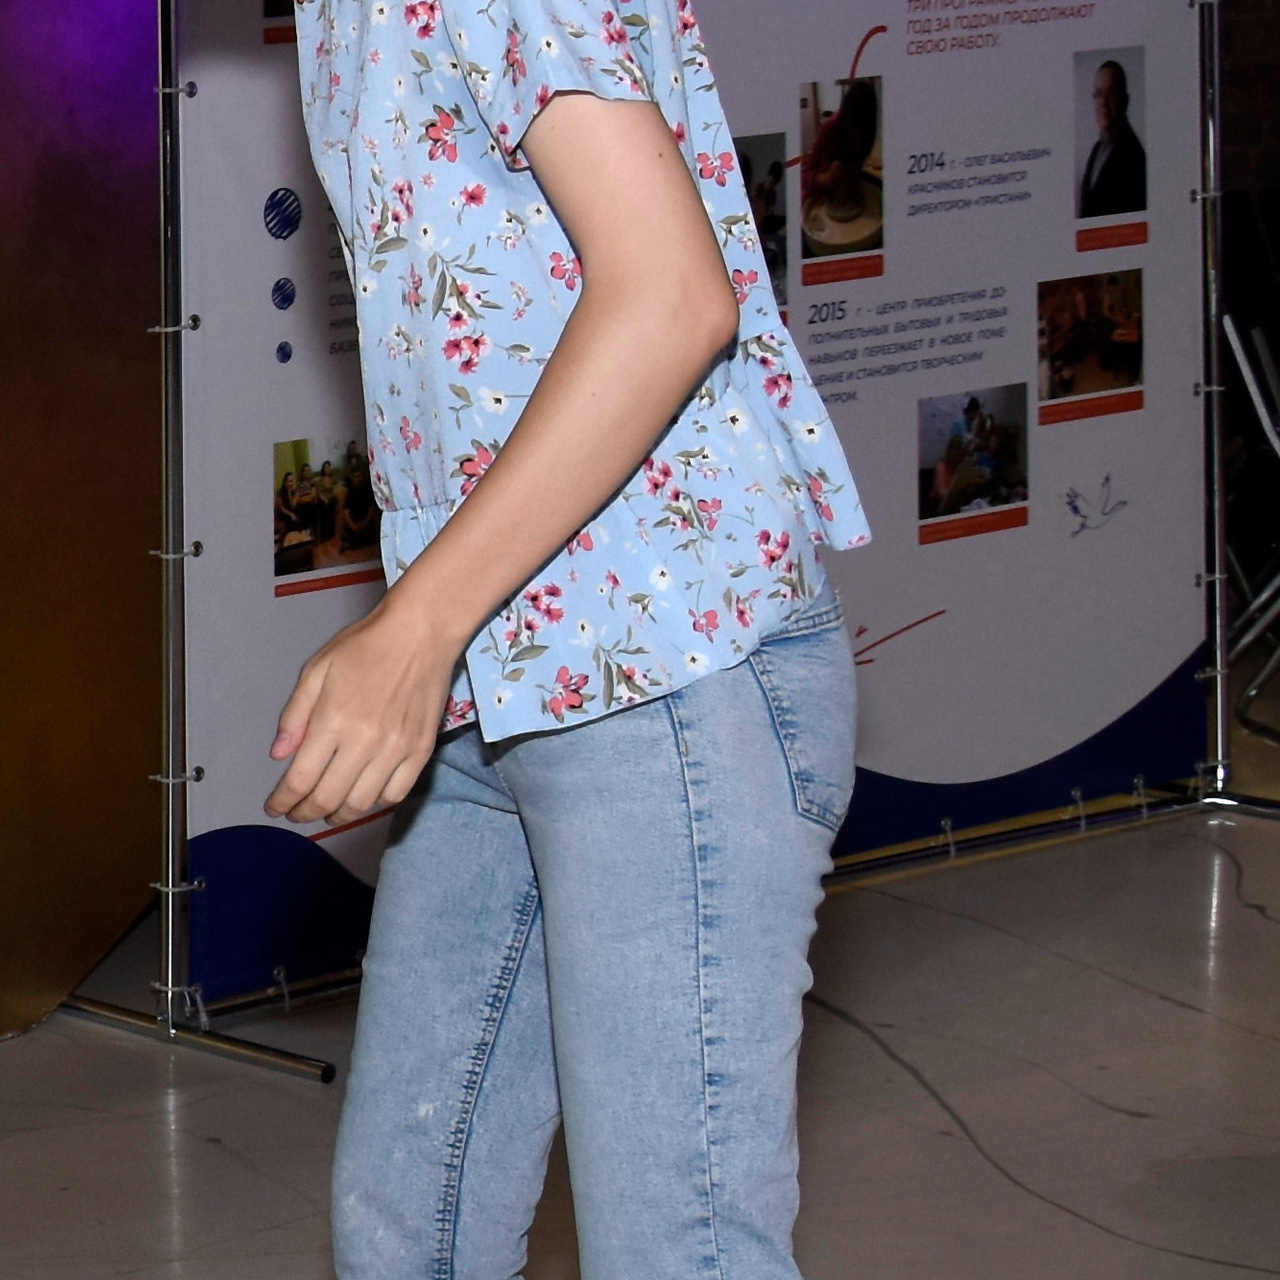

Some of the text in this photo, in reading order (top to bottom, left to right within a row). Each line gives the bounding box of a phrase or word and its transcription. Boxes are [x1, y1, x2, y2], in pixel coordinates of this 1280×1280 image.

[907, 2, 1097, 35] ГОД ЗА ГОДОМ ПРОДОЛЖАЮТ
[906, 38, 947, 56] СВОЮ
[907, 151, 946, 174] 2014
[807, 300, 847, 324] 2015
[875, 299, 908, 315] ЦЕНТР
[911, 288, 987, 311] ПРИОБРЕТЕНИЯ
[808, 306, 1007, 345] ПОЛНИТЕЛЬНЫХ БЫТОВЫХ И ТРУДОВЫХ
[809, 349, 858, 366] НАВЫКОВ
[862, 339, 924, 358] ПЕРЕЕЗЖАЕТ
[928, 338, 935, 349] В
[940, 330, 973, 346] НОВОЕ
[855, 360, 919, 381] СТАНОВИТСЯ
[921, 351, 984, 369] ТВОРЧЕСКИМ
